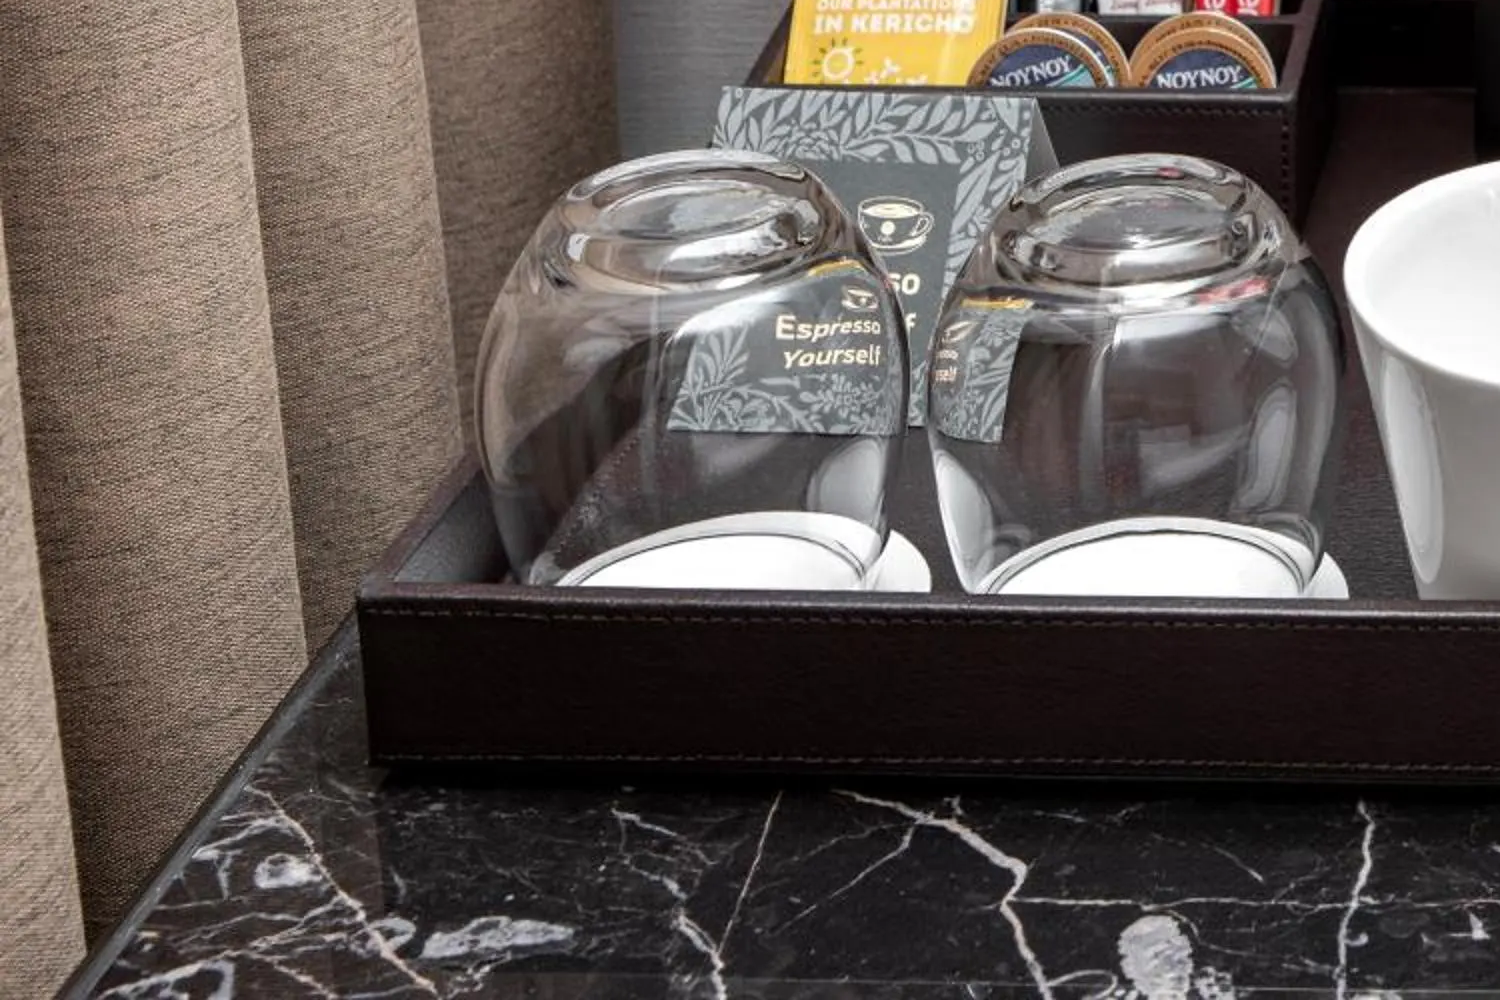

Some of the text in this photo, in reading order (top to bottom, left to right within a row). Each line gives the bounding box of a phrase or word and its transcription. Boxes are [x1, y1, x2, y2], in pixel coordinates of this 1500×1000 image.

[813, 13, 976, 35] IN KERICHO
[1156, 65, 1242, 88] NOYNOY
[775, 313, 881, 343] Espresso
[783, 343, 881, 369] Yourself
